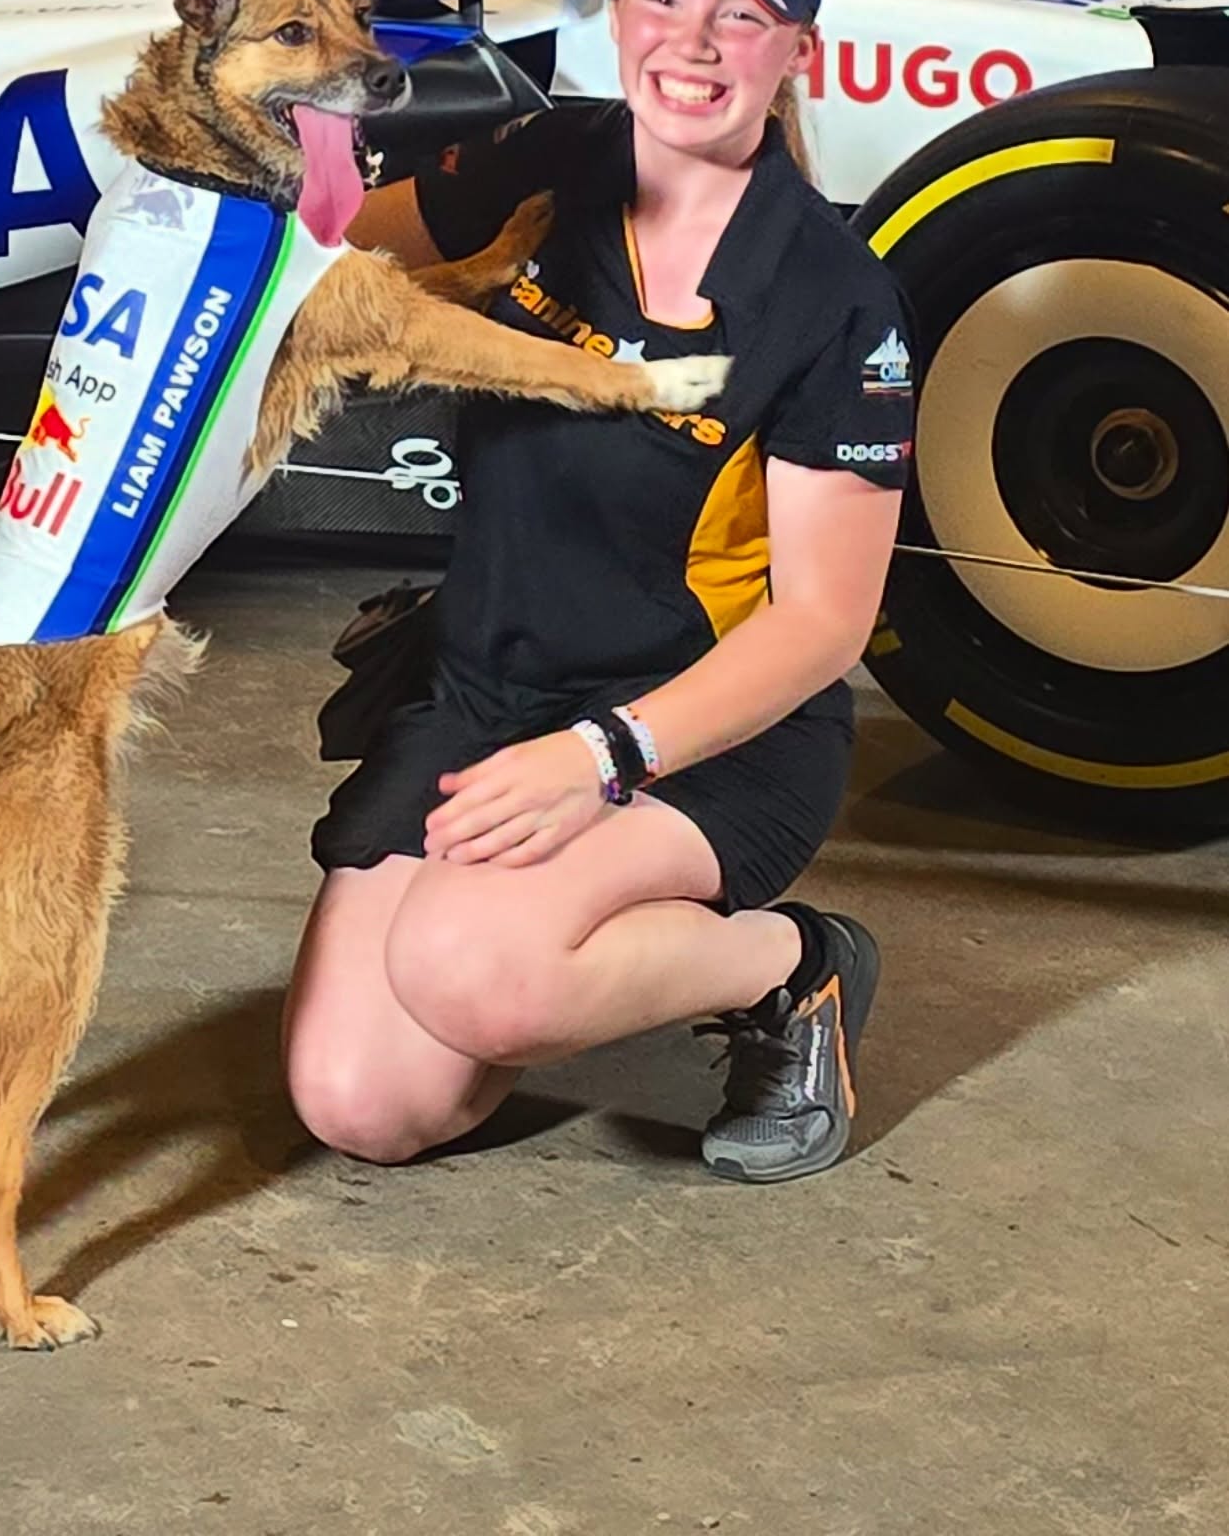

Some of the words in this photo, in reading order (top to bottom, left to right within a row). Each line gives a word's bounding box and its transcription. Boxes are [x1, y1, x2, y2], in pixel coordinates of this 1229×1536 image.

[65, 364, 117, 403] App
[112, 437, 167, 519] LIAM
[153, 286, 232, 430] PAWSON
[836, 444, 899, 461] DOGS
